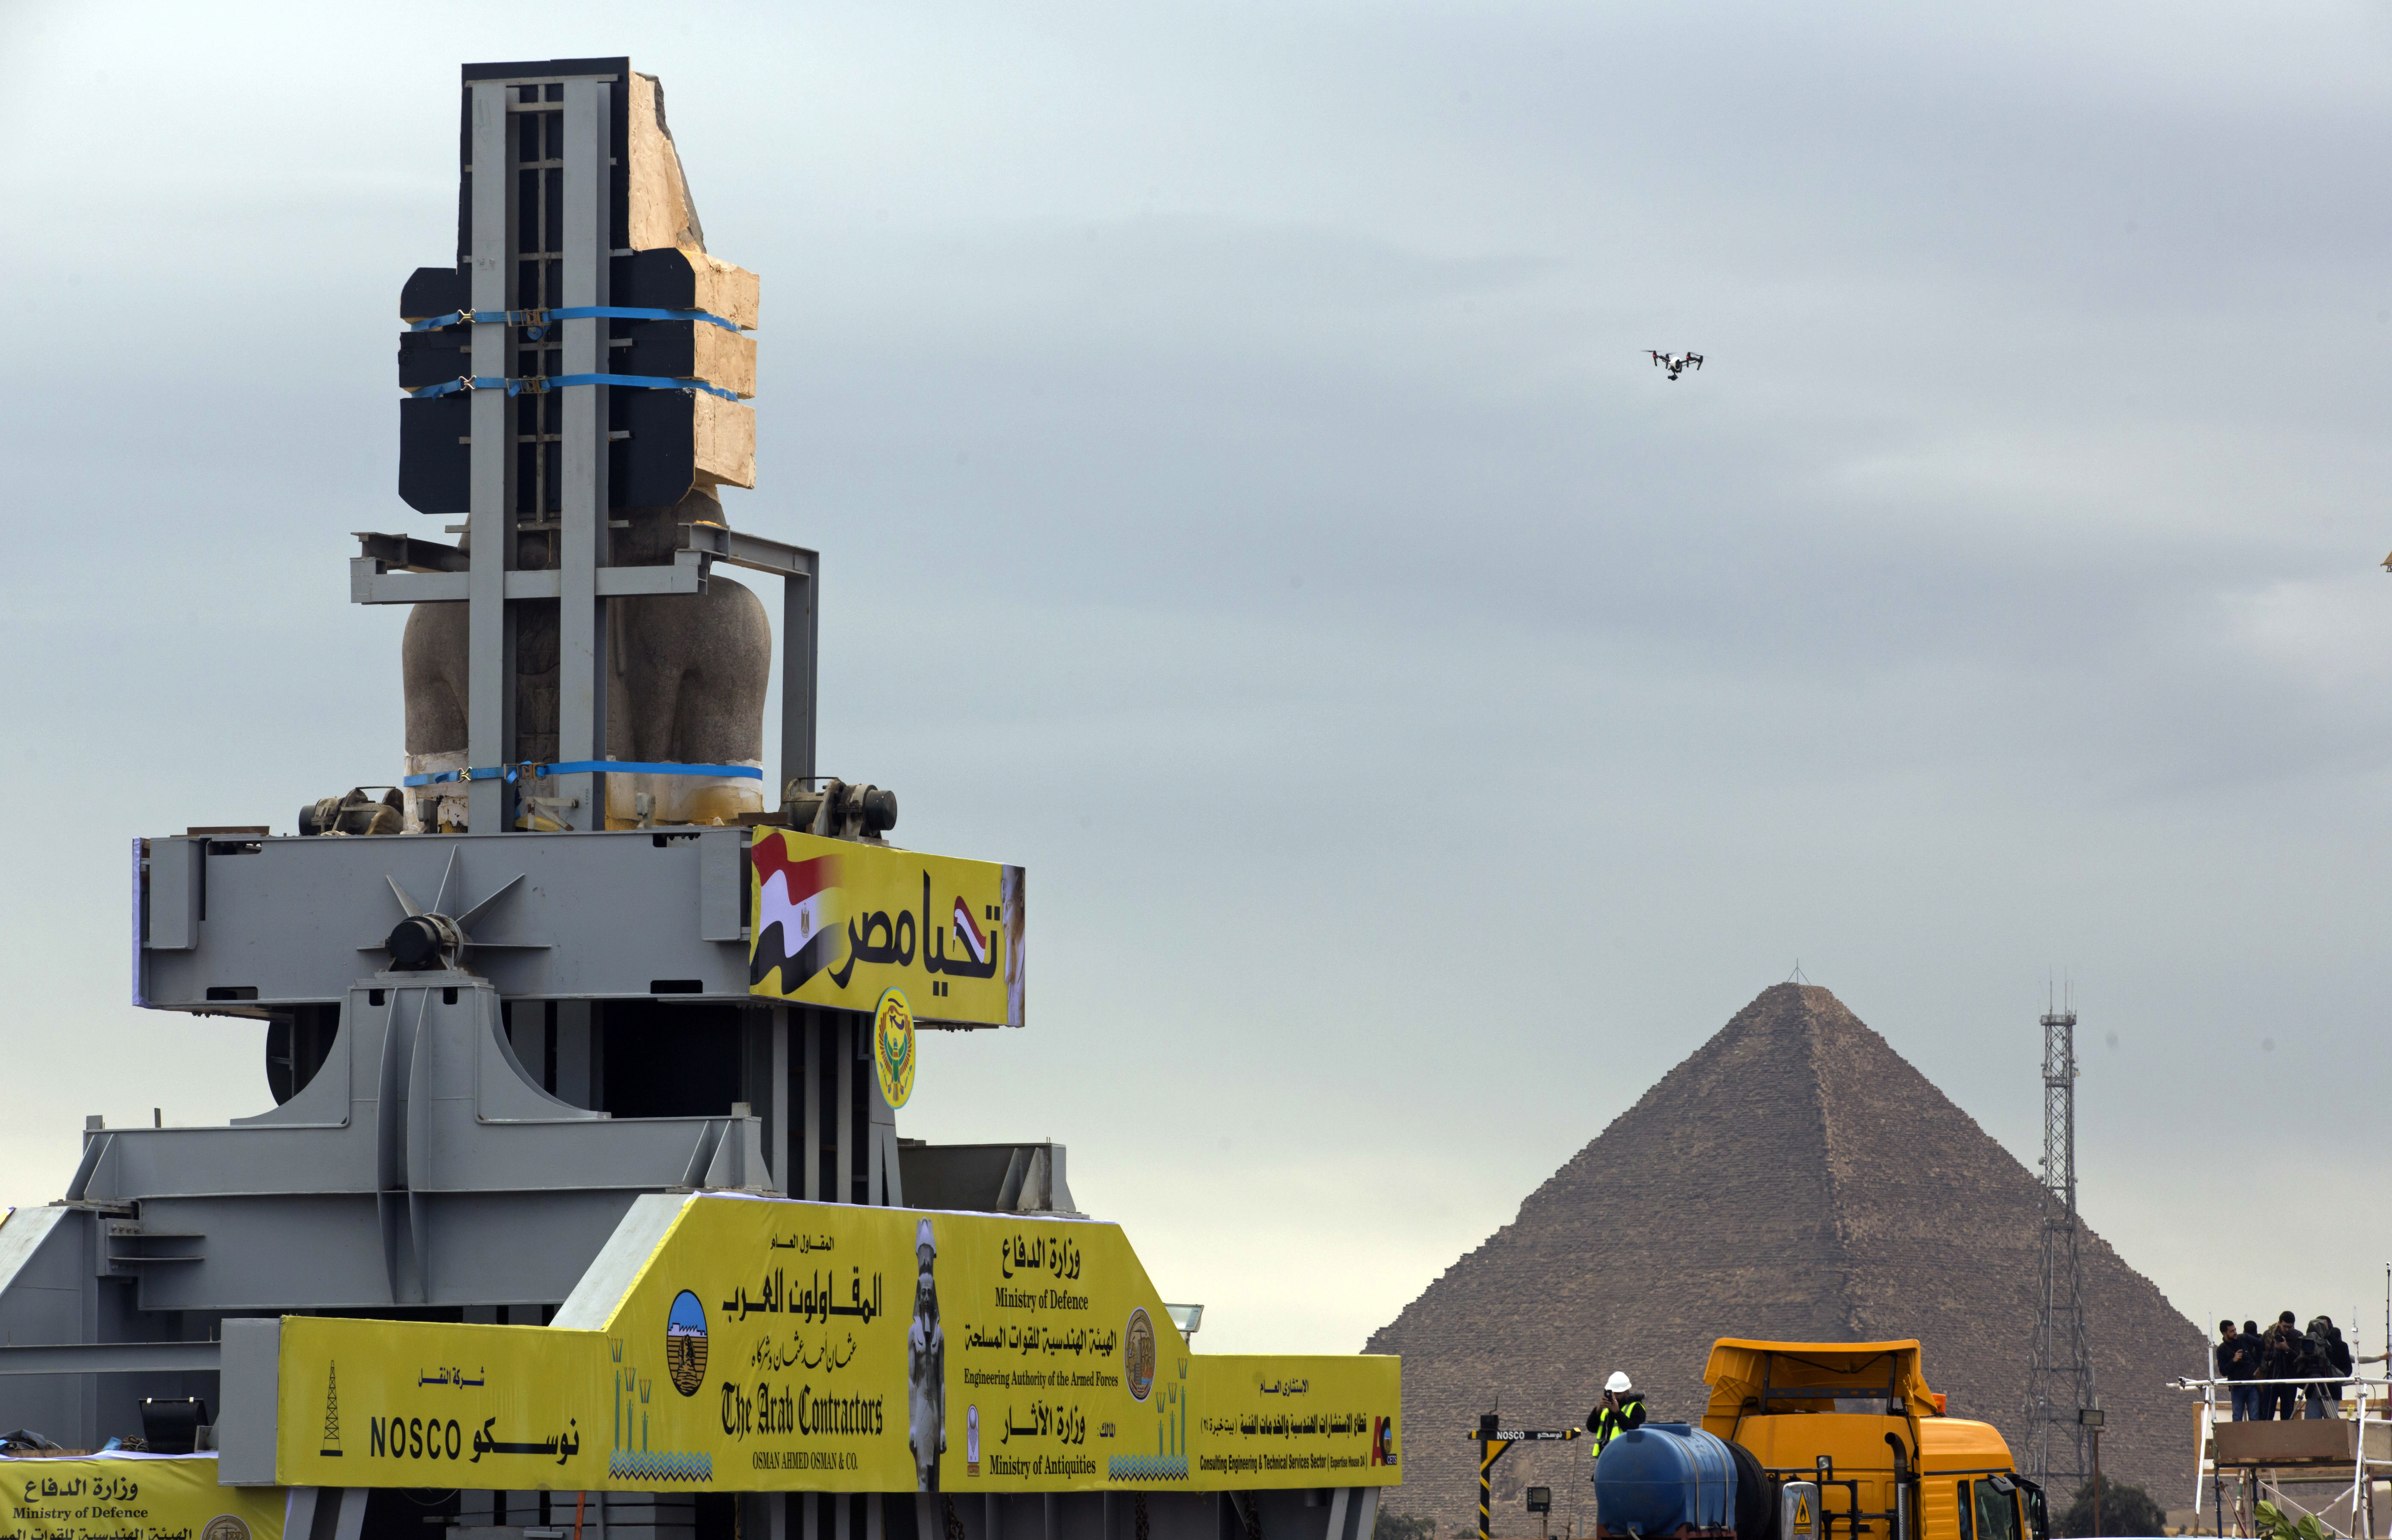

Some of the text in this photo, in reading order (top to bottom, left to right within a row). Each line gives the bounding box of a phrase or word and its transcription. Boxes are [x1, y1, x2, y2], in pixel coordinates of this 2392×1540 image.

[827, 869, 1000, 997] تحيا مصر
[770, 1232, 834, 1254] المقاول العام
[1002, 1234, 1080, 1280] وزارة الدفاع
[722, 1266, 882, 1324] المقاولون العرب
[995, 1287, 1088, 1313] Ministry of Defence
[773, 1330, 804, 1371] عثمان
[801, 1331, 827, 1369] أحمد
[826, 1333, 857, 1373] عثمان
[965, 1324, 1116, 1357] الهيئة الهندسية للقوات المسلحة
[418, 1366, 484, 1390] شركة النقل
[964, 1368, 1118, 1389] Engineering Authority of the Armed Forces
[1260, 1379, 1281, 1398] العام
[721, 1382, 882, 1443] The Arab Contractors
[1000, 1400, 1052, 1445] الآثار
[1057, 1405, 1085, 1445] وزارة
[1354, 1413, 1366, 1437] قطاع
[371, 1416, 461, 1460] NOSCO
[1210, 1418, 1224, 1436] خبرة
[1240, 1413, 1258, 1439] الفنية
[1260, 1413, 1289, 1439] والخدمات
[1291, 1413, 1317, 1439] الهندسية
[1497, 1431, 1525, 1440] NOSCO
[1537, 1431, 1563, 1440] نوسكو
[469, 1416, 579, 1465] نوسكو
[752, 1451, 858, 1470] OSMAN AHMED OSMAN & CO.
[990, 1454, 1095, 1480] Ministry of Antiquities
[1200, 1454, 1227, 1474] Consulting
[1229, 1454, 1257, 1474] Engineering
[1258, 1454, 1262, 1470] &
[1264, 1454, 1288, 1469] Technical
[1289, 1454, 1309, 1469] Services
[1311, 1453, 1326, 1469] Sector
[1348, 1456, 1359, 1467] House
[24, 1477, 138, 1503] وزارة الدفاع
[12, 1507, 148, 1521] Ministry of Defence
